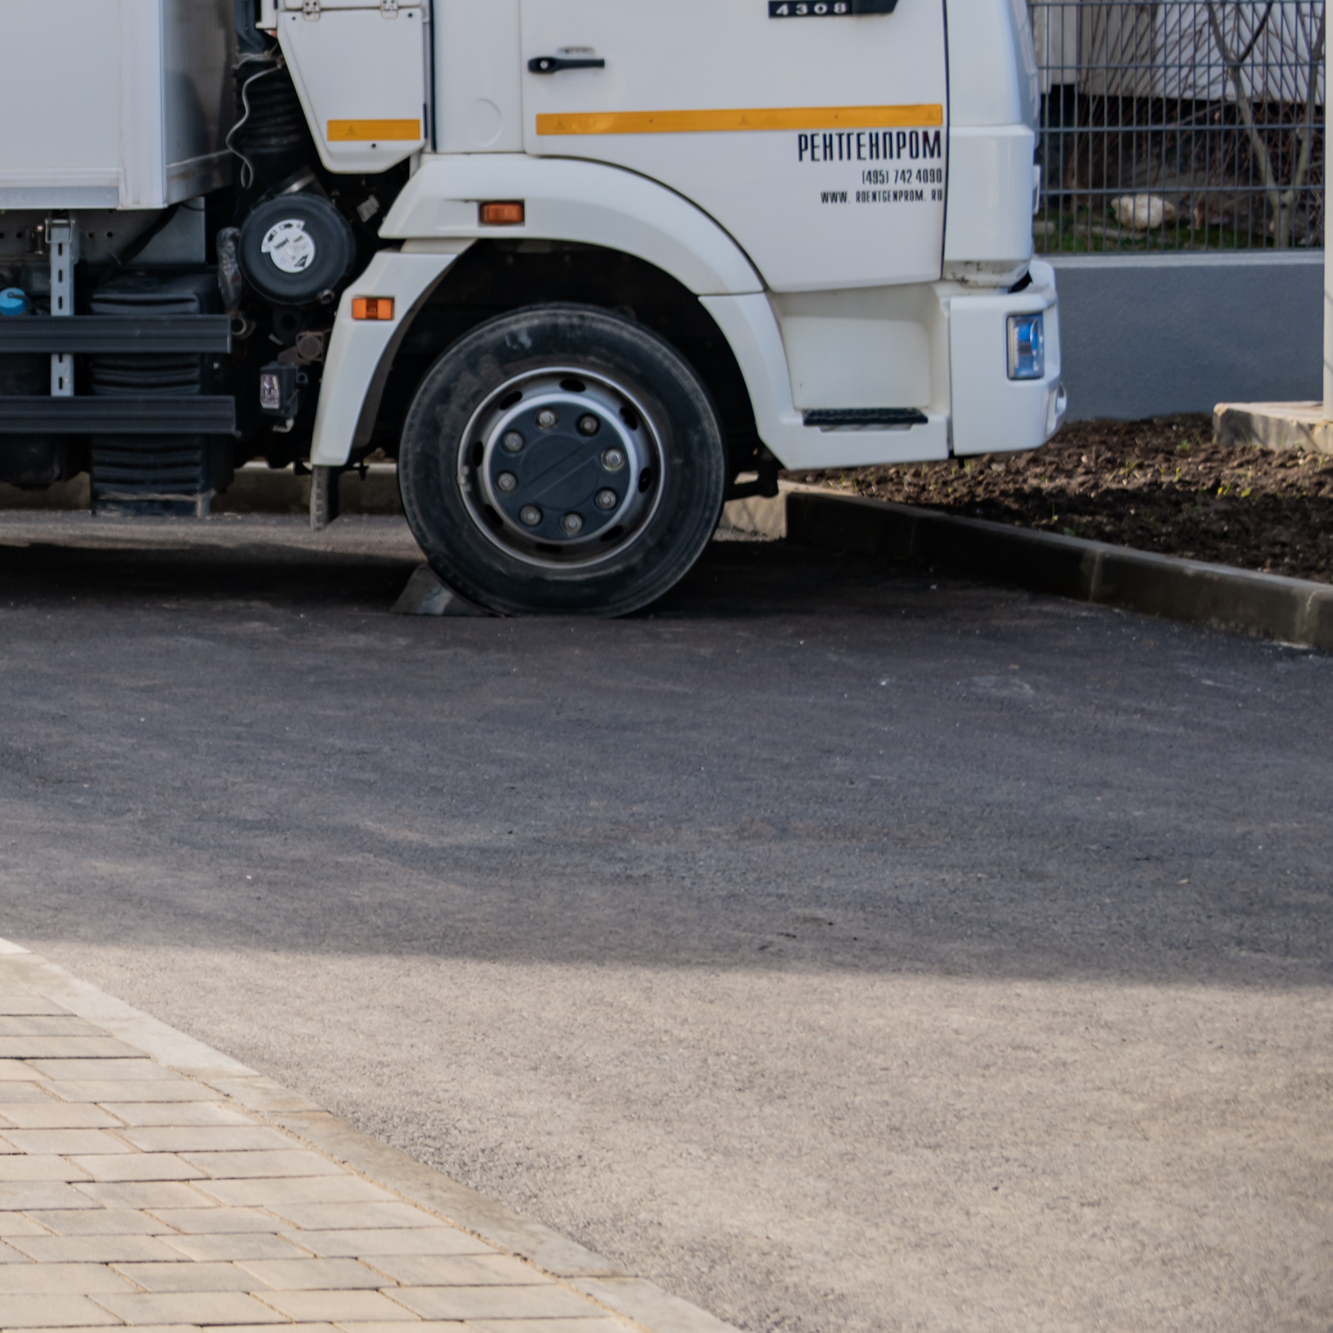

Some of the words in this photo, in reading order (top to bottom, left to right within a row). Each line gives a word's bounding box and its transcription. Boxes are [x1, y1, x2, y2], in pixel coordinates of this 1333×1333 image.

[776, 2, 848, 16] 4308
[798, 131, 942, 162] РЕНТГЕНПРОМ
[862, 170, 889, 185] (495)
[894, 169, 912, 184] 742
[916, 168, 942, 183] 4090
